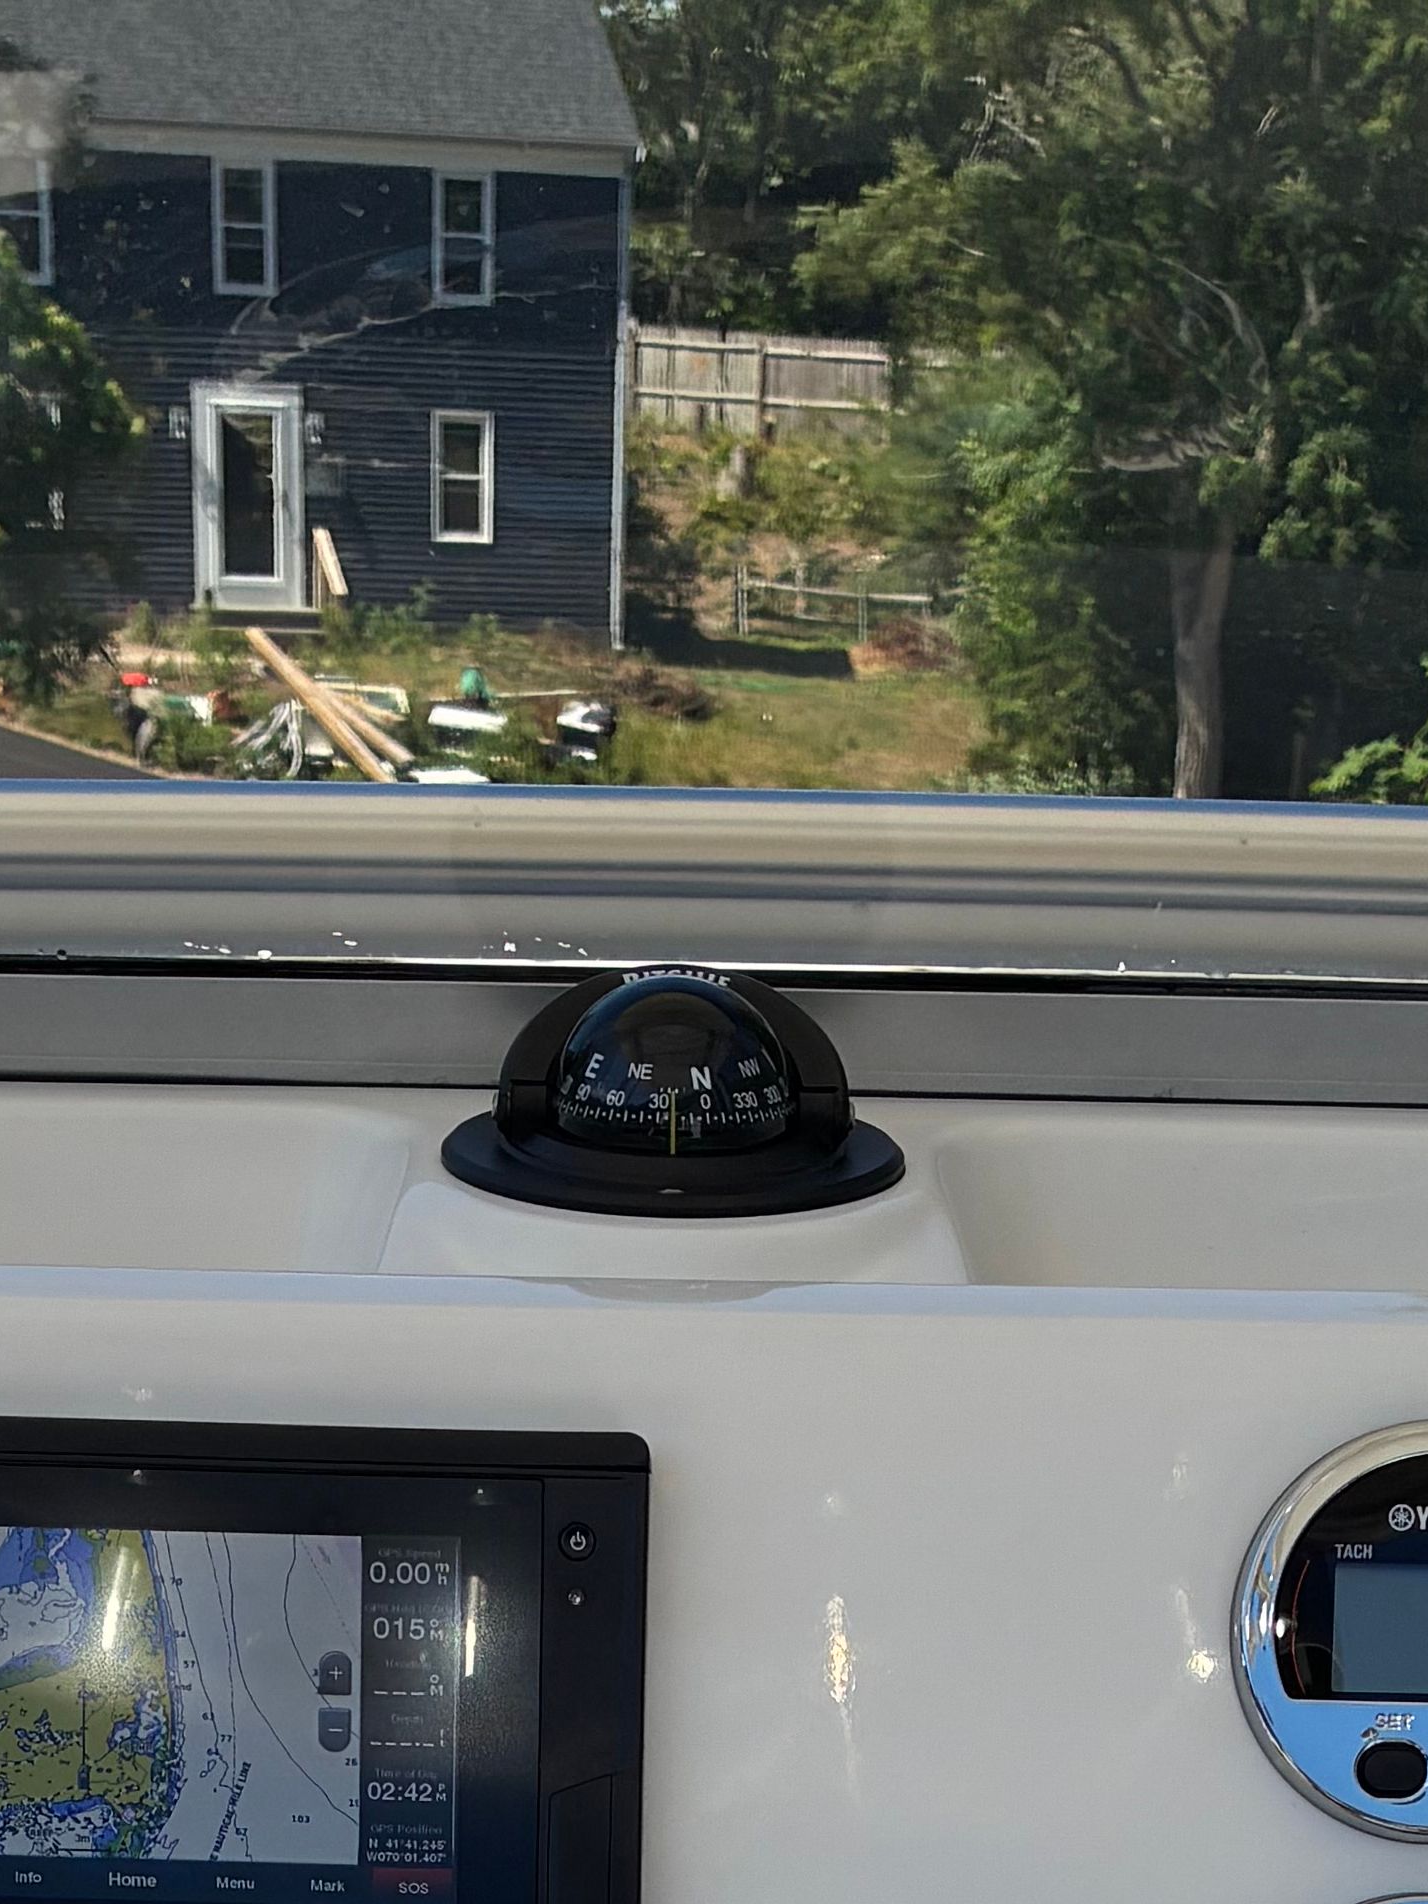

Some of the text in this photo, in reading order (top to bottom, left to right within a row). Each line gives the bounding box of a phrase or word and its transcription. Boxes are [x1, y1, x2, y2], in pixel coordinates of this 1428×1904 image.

[585, 1053, 761, 1091] E NE N NW
[574, 1084, 591, 1101] 90
[606, 1090, 625, 1106] 60
[648, 1093, 668, 1109] 30
[699, 1093, 712, 1110] 0
[733, 1091, 758, 1108] 330
[1334, 1544, 1373, 1560] TACH
[369, 1561, 431, 1585] 0.00
[373, 1617, 425, 1640] 015
[1374, 1713, 1416, 1730] SET
[367, 1781, 433, 1802] 02:42
[291, 1815, 311, 1824] 103
[14, 1869, 43, 1884] Info
[108, 1871, 157, 1888] Home
[216, 1876, 256, 1890] Menu
[310, 1878, 346, 1892] Mark
[398, 1882, 429, 1895] SOS
